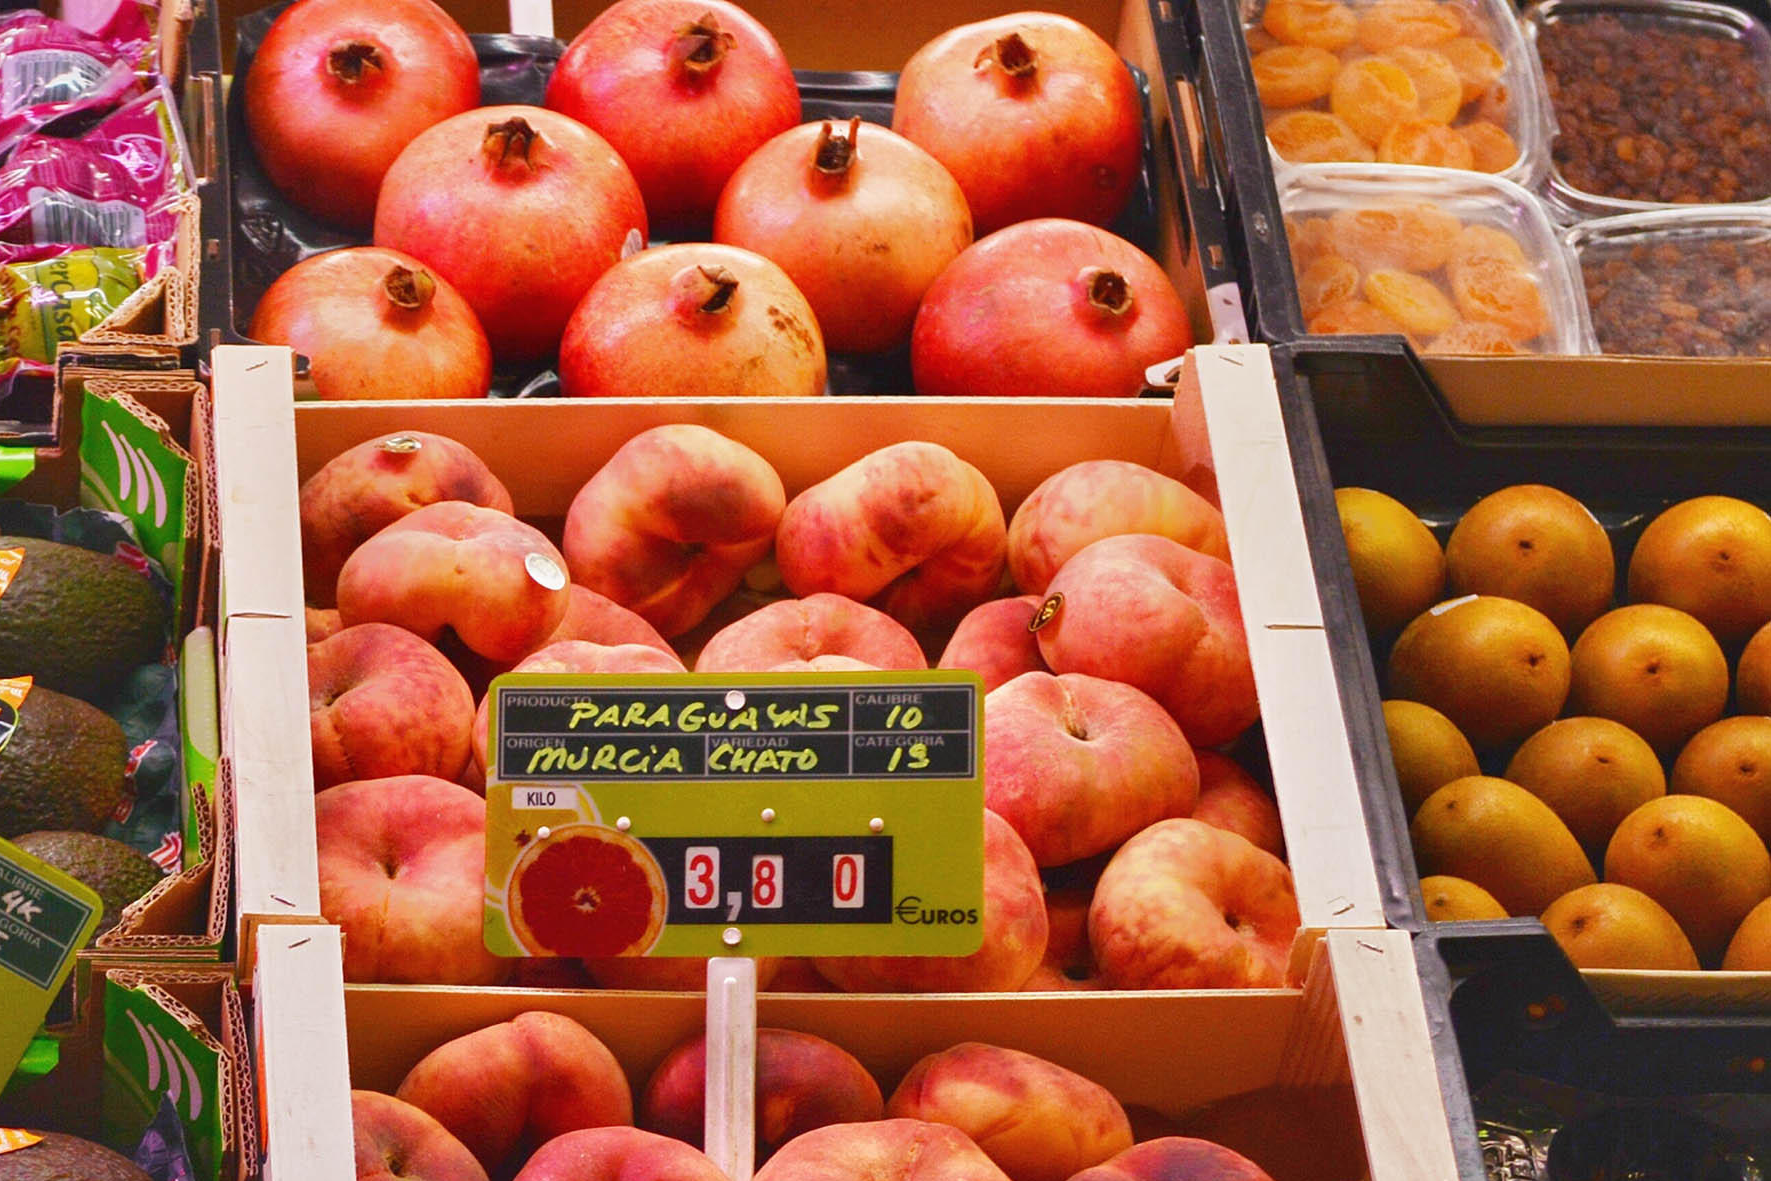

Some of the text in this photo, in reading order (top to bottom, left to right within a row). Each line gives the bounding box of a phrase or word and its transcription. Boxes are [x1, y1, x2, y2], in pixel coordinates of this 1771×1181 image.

[506, 694, 592, 708] PRODUCTO
[855, 692, 923, 705] CALIBRE
[885, 705, 924, 730] 10
[710, 735, 790, 749] VARIEDAD
[708, 743, 819, 773] CHATO
[526, 790, 557, 808] KILO
